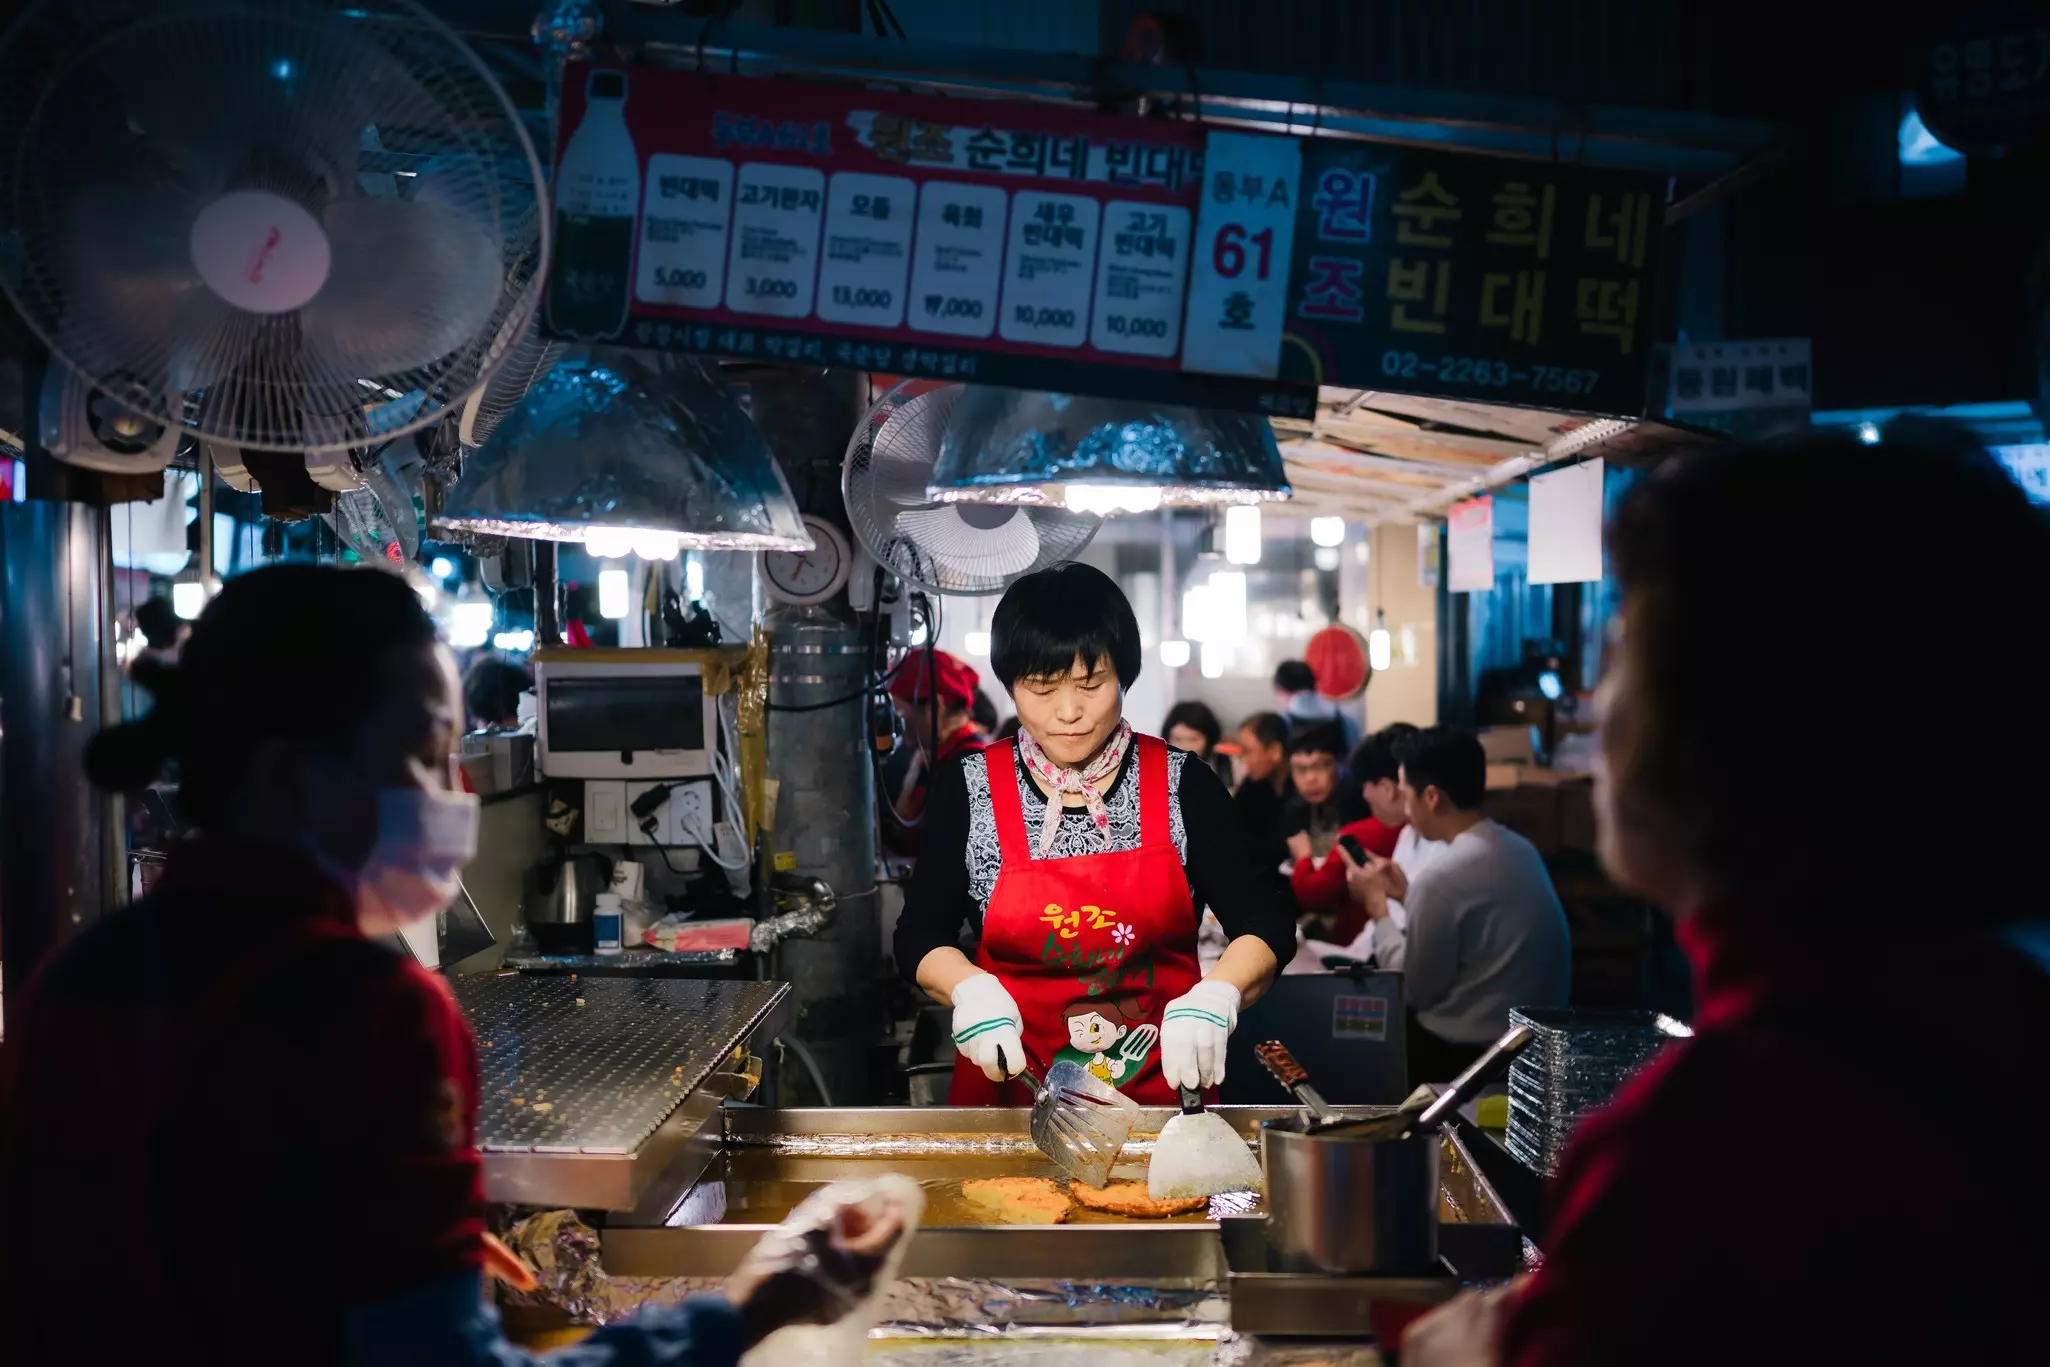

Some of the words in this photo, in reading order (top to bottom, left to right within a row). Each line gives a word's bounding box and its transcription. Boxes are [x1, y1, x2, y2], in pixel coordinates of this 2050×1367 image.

[965, 123, 1089, 181] 순희네
[659, 175, 720, 203] 빈대떡
[740, 184, 820, 213] 고기완자
[1213, 170, 1290, 209] 동부A
[1034, 202, 1075, 225] 새우
[1127, 211, 1168, 234] 고기
[1390, 170, 1651, 268] 순희네
[1023, 223, 1085, 251] 빈대떡
[1115, 233, 1177, 260] 빈대떡
[1213, 223, 1274, 280] 61
[1300, 167, 1377, 324] 원조
[655, 268, 706, 291] 5,000
[745, 275, 797, 299] 3,000
[1016, 305, 1075, 328] 10,000
[1218, 291, 1255, 330] 호
[1387, 257, 1641, 355] 빈대떡
[1106, 315, 1168, 339] 10,000
[1380, 350, 1600, 395] 02-2263-7567
[1040, 903, 1116, 938] 원조
